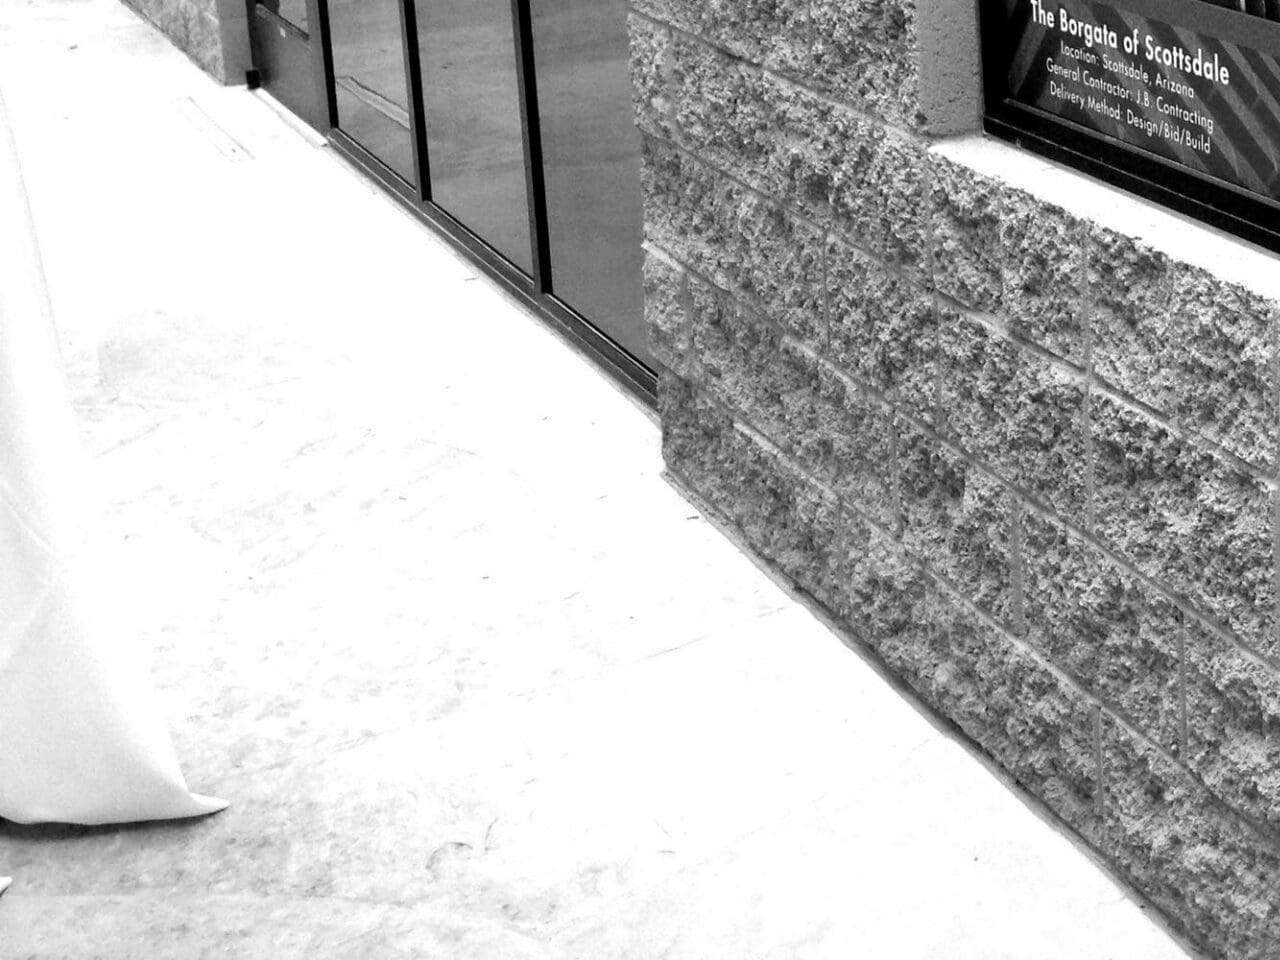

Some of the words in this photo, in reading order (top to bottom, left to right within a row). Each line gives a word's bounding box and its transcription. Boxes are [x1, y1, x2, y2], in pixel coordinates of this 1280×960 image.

[1059, 8, 1118, 48] Borgata
[1123, 28, 1139, 56] of
[1145, 35, 1230, 85] Scottsdale
[1060, 40, 1100, 63] Location:
[1102, 54, 1152, 86] Scottsdale,
[1155, 72, 1194, 99] Arizona
[1046, 57, 1080, 82] General
[1083, 70, 1133, 101] Contractor:
[1135, 90, 1153, 108] J.B.
[1156, 96, 1214, 135] Contracting
[1050, 80, 1085, 110] Delivery
[1087, 96, 1124, 121] Method:
[1127, 109, 1211, 155] Design/Bid/Build
